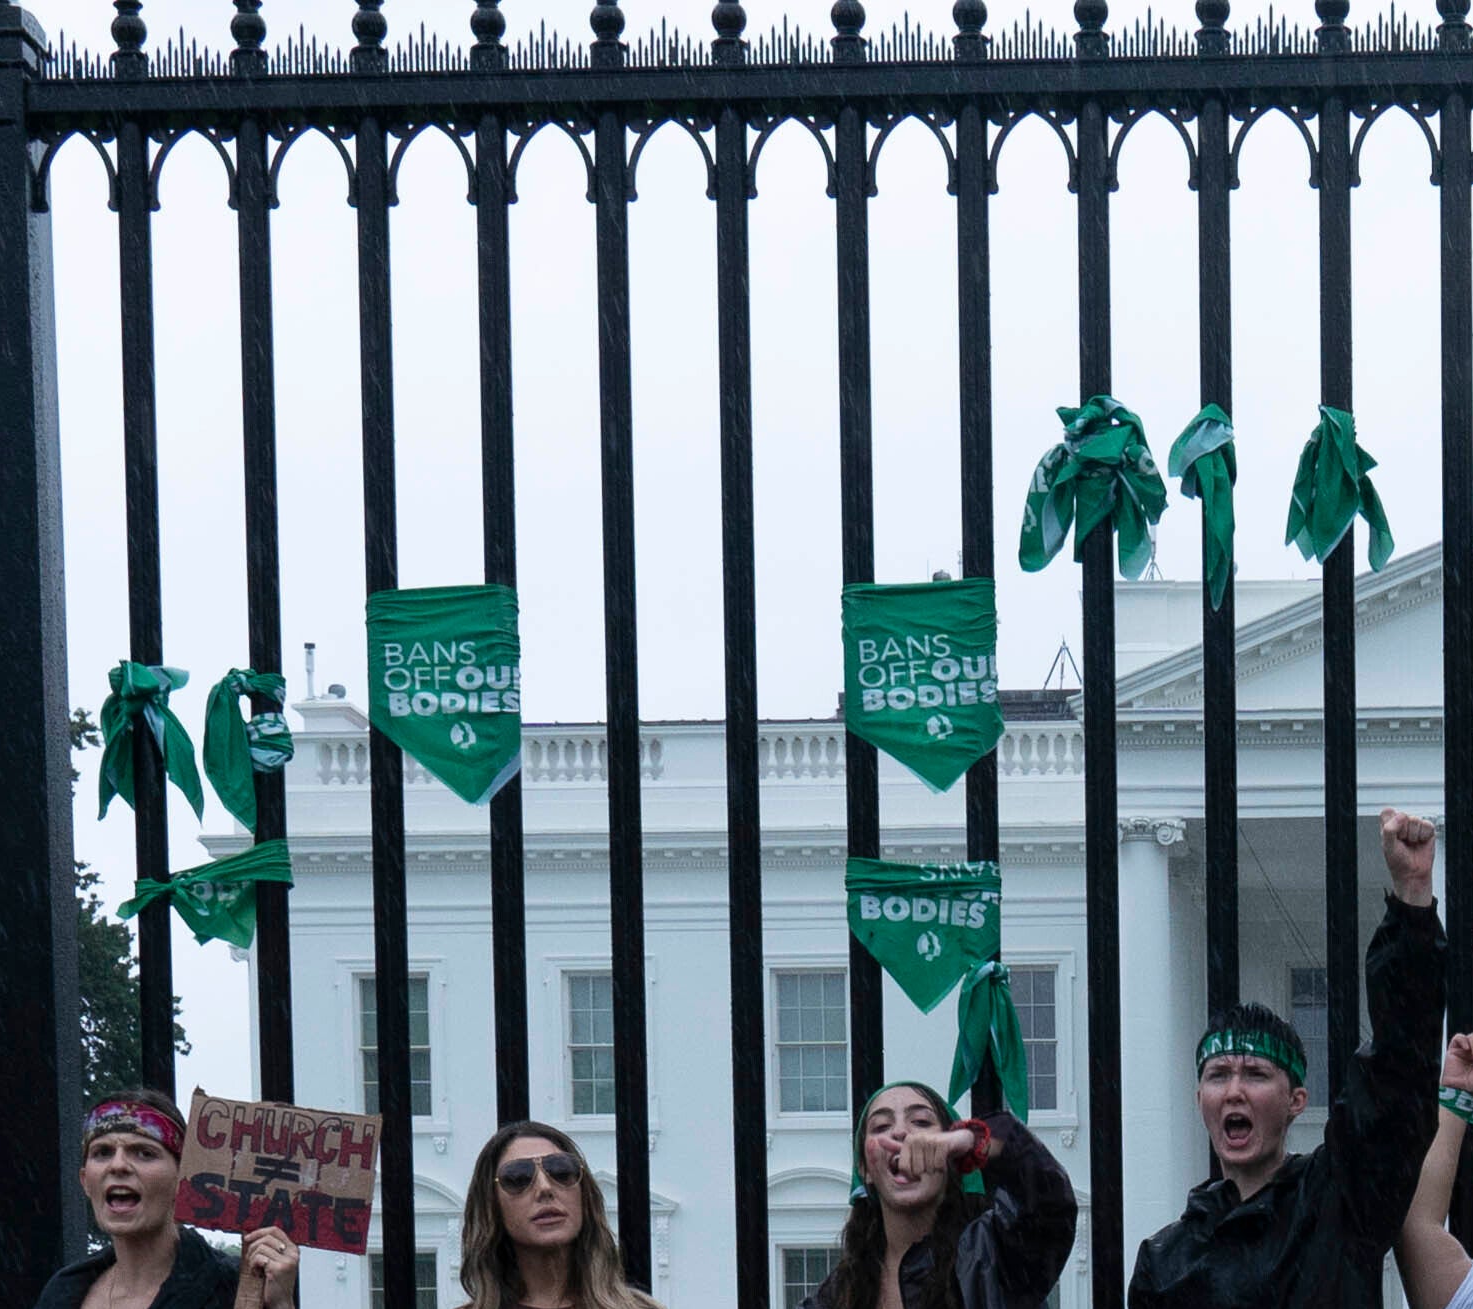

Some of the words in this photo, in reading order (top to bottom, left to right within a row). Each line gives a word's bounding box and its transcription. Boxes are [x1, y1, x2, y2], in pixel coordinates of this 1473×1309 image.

[383, 641, 476, 666] BANS
[858, 634, 951, 664] BANS
[383, 666, 451, 690] OFF
[858, 660, 927, 688] OFF
[388, 690, 520, 717] BODIES
[862, 680, 997, 712] BODIES
[860, 895, 987, 929] BODIES
[197, 1100, 376, 1170] CHURCH
[190, 1172, 367, 1245] STATE
